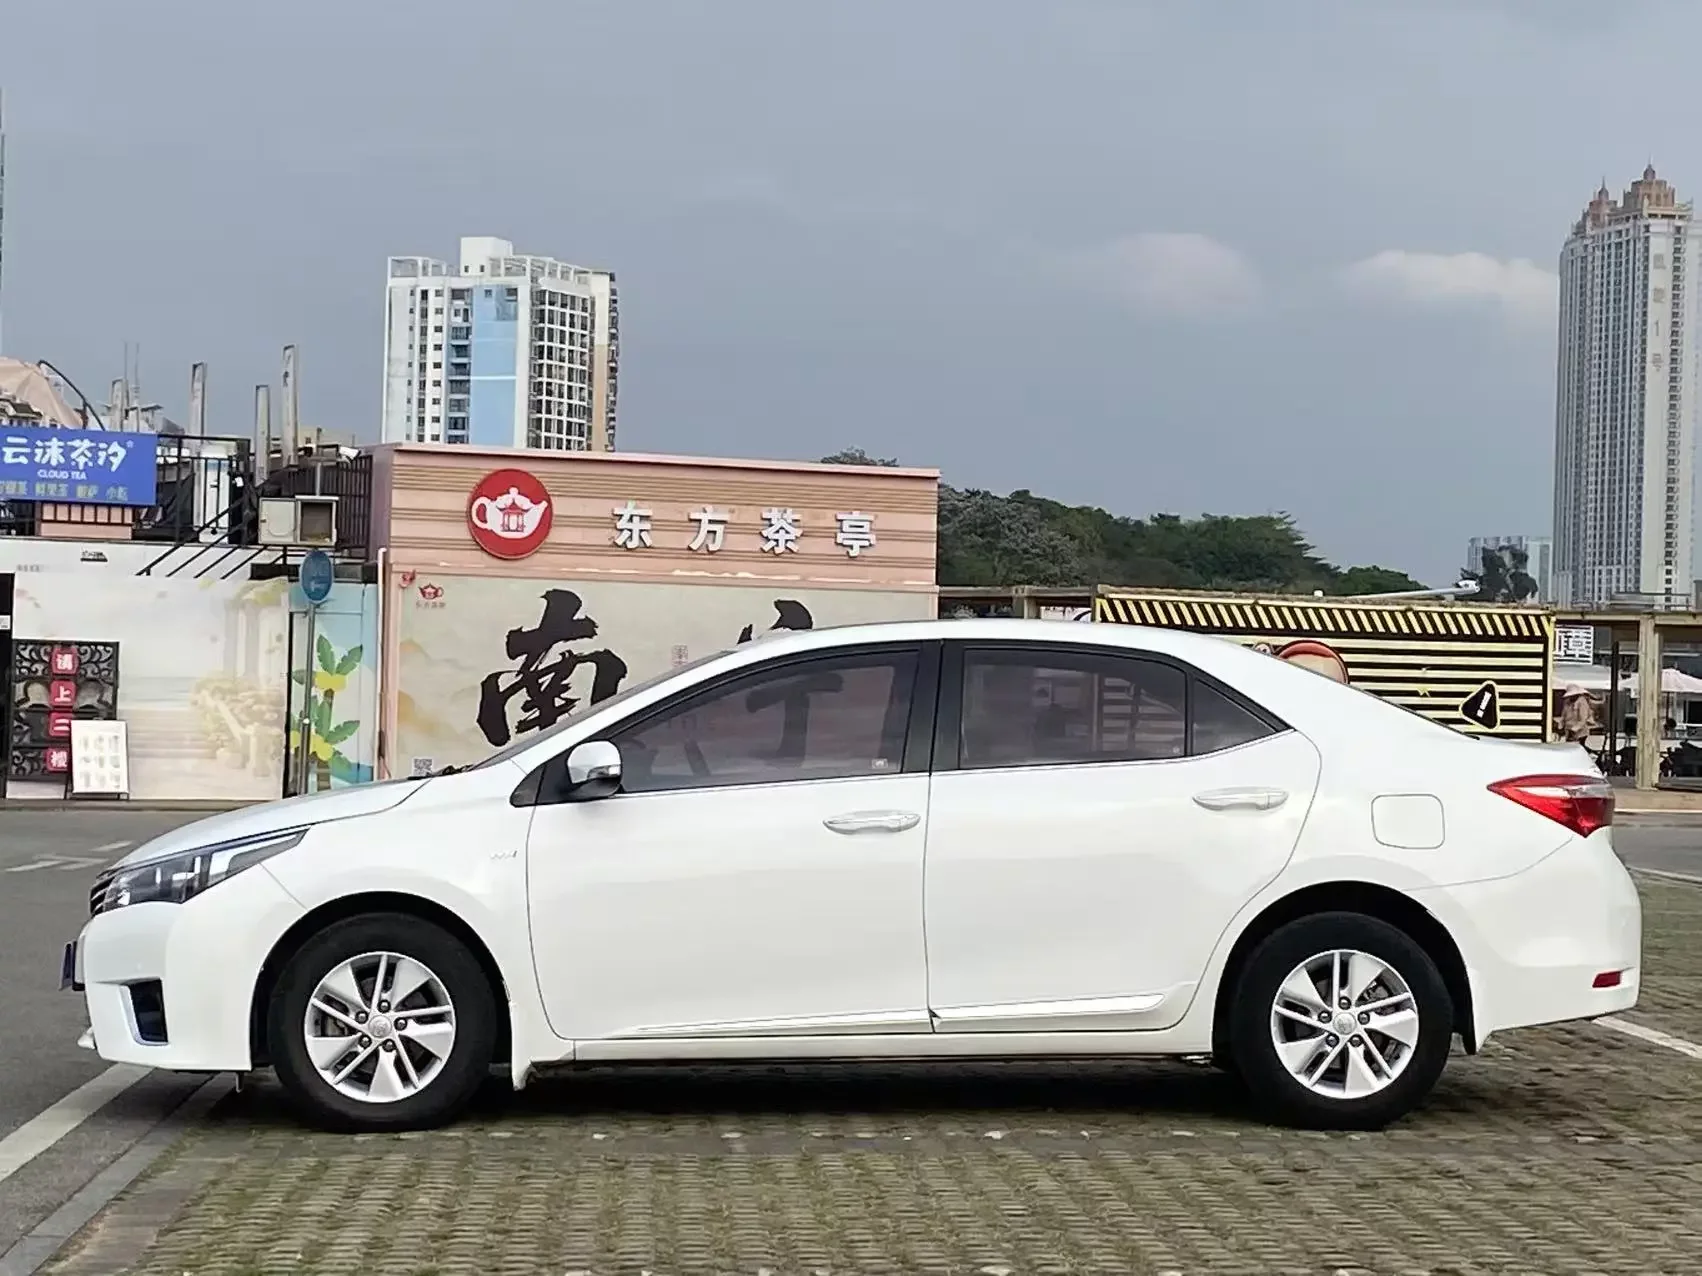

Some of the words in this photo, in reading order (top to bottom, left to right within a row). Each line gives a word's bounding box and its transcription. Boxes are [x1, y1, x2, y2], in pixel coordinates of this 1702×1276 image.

[37, 469, 69, 479] CLOUD
[71, 471, 87, 480] TEA
[611, 500, 877, 558] 东方茶亭
